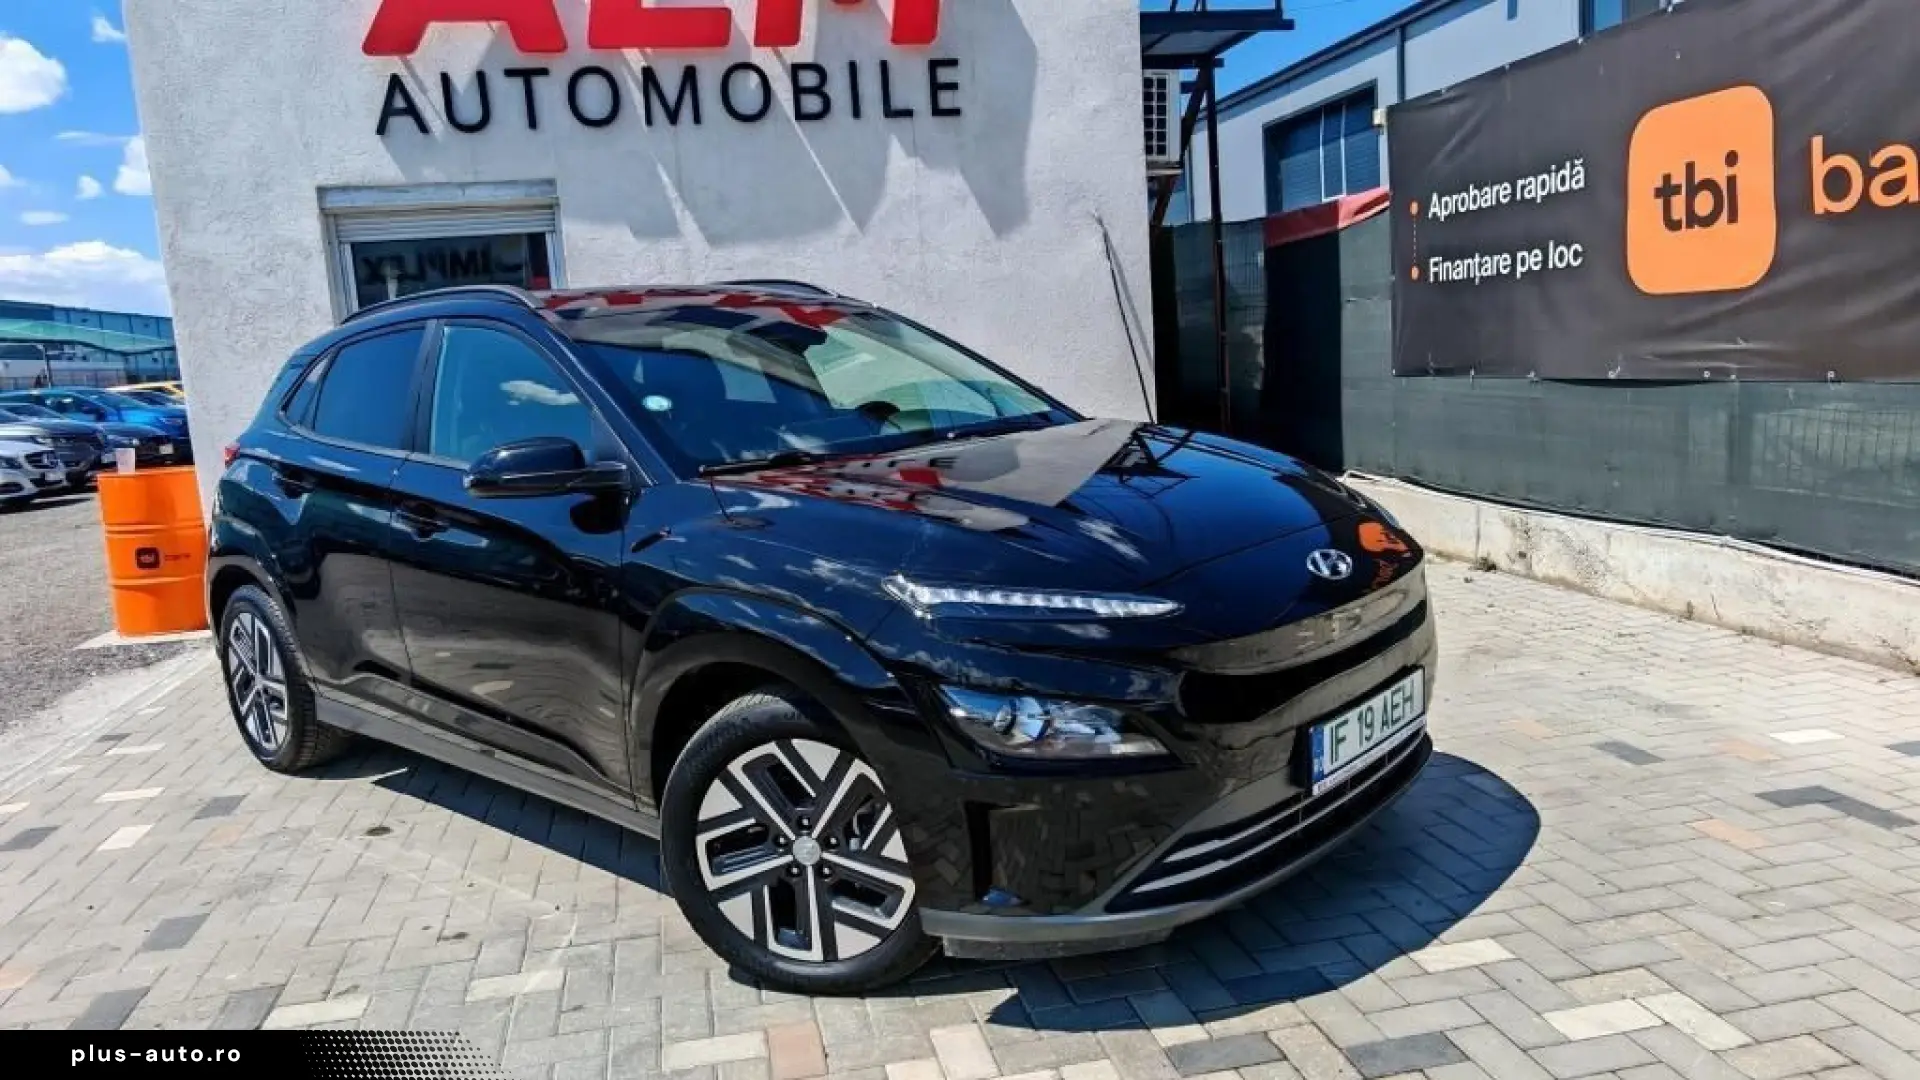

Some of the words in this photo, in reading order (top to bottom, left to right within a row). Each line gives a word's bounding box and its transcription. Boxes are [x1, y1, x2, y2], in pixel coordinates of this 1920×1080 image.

[375, 57, 962, 136] AUTOMOBILE
[1428, 181, 1511, 221] Aprobare
[1516, 158, 1586, 203] rapidă
[1653, 149, 1739, 232] tbi
[1429, 252, 1511, 285] Finanțare
[1516, 248, 1543, 279] pe
[1548, 240, 1584, 268] loc
[1330, 719, 1349, 765] IF
[1357, 704, 1375, 747] 19
[1380, 678, 1414, 732] AEH
